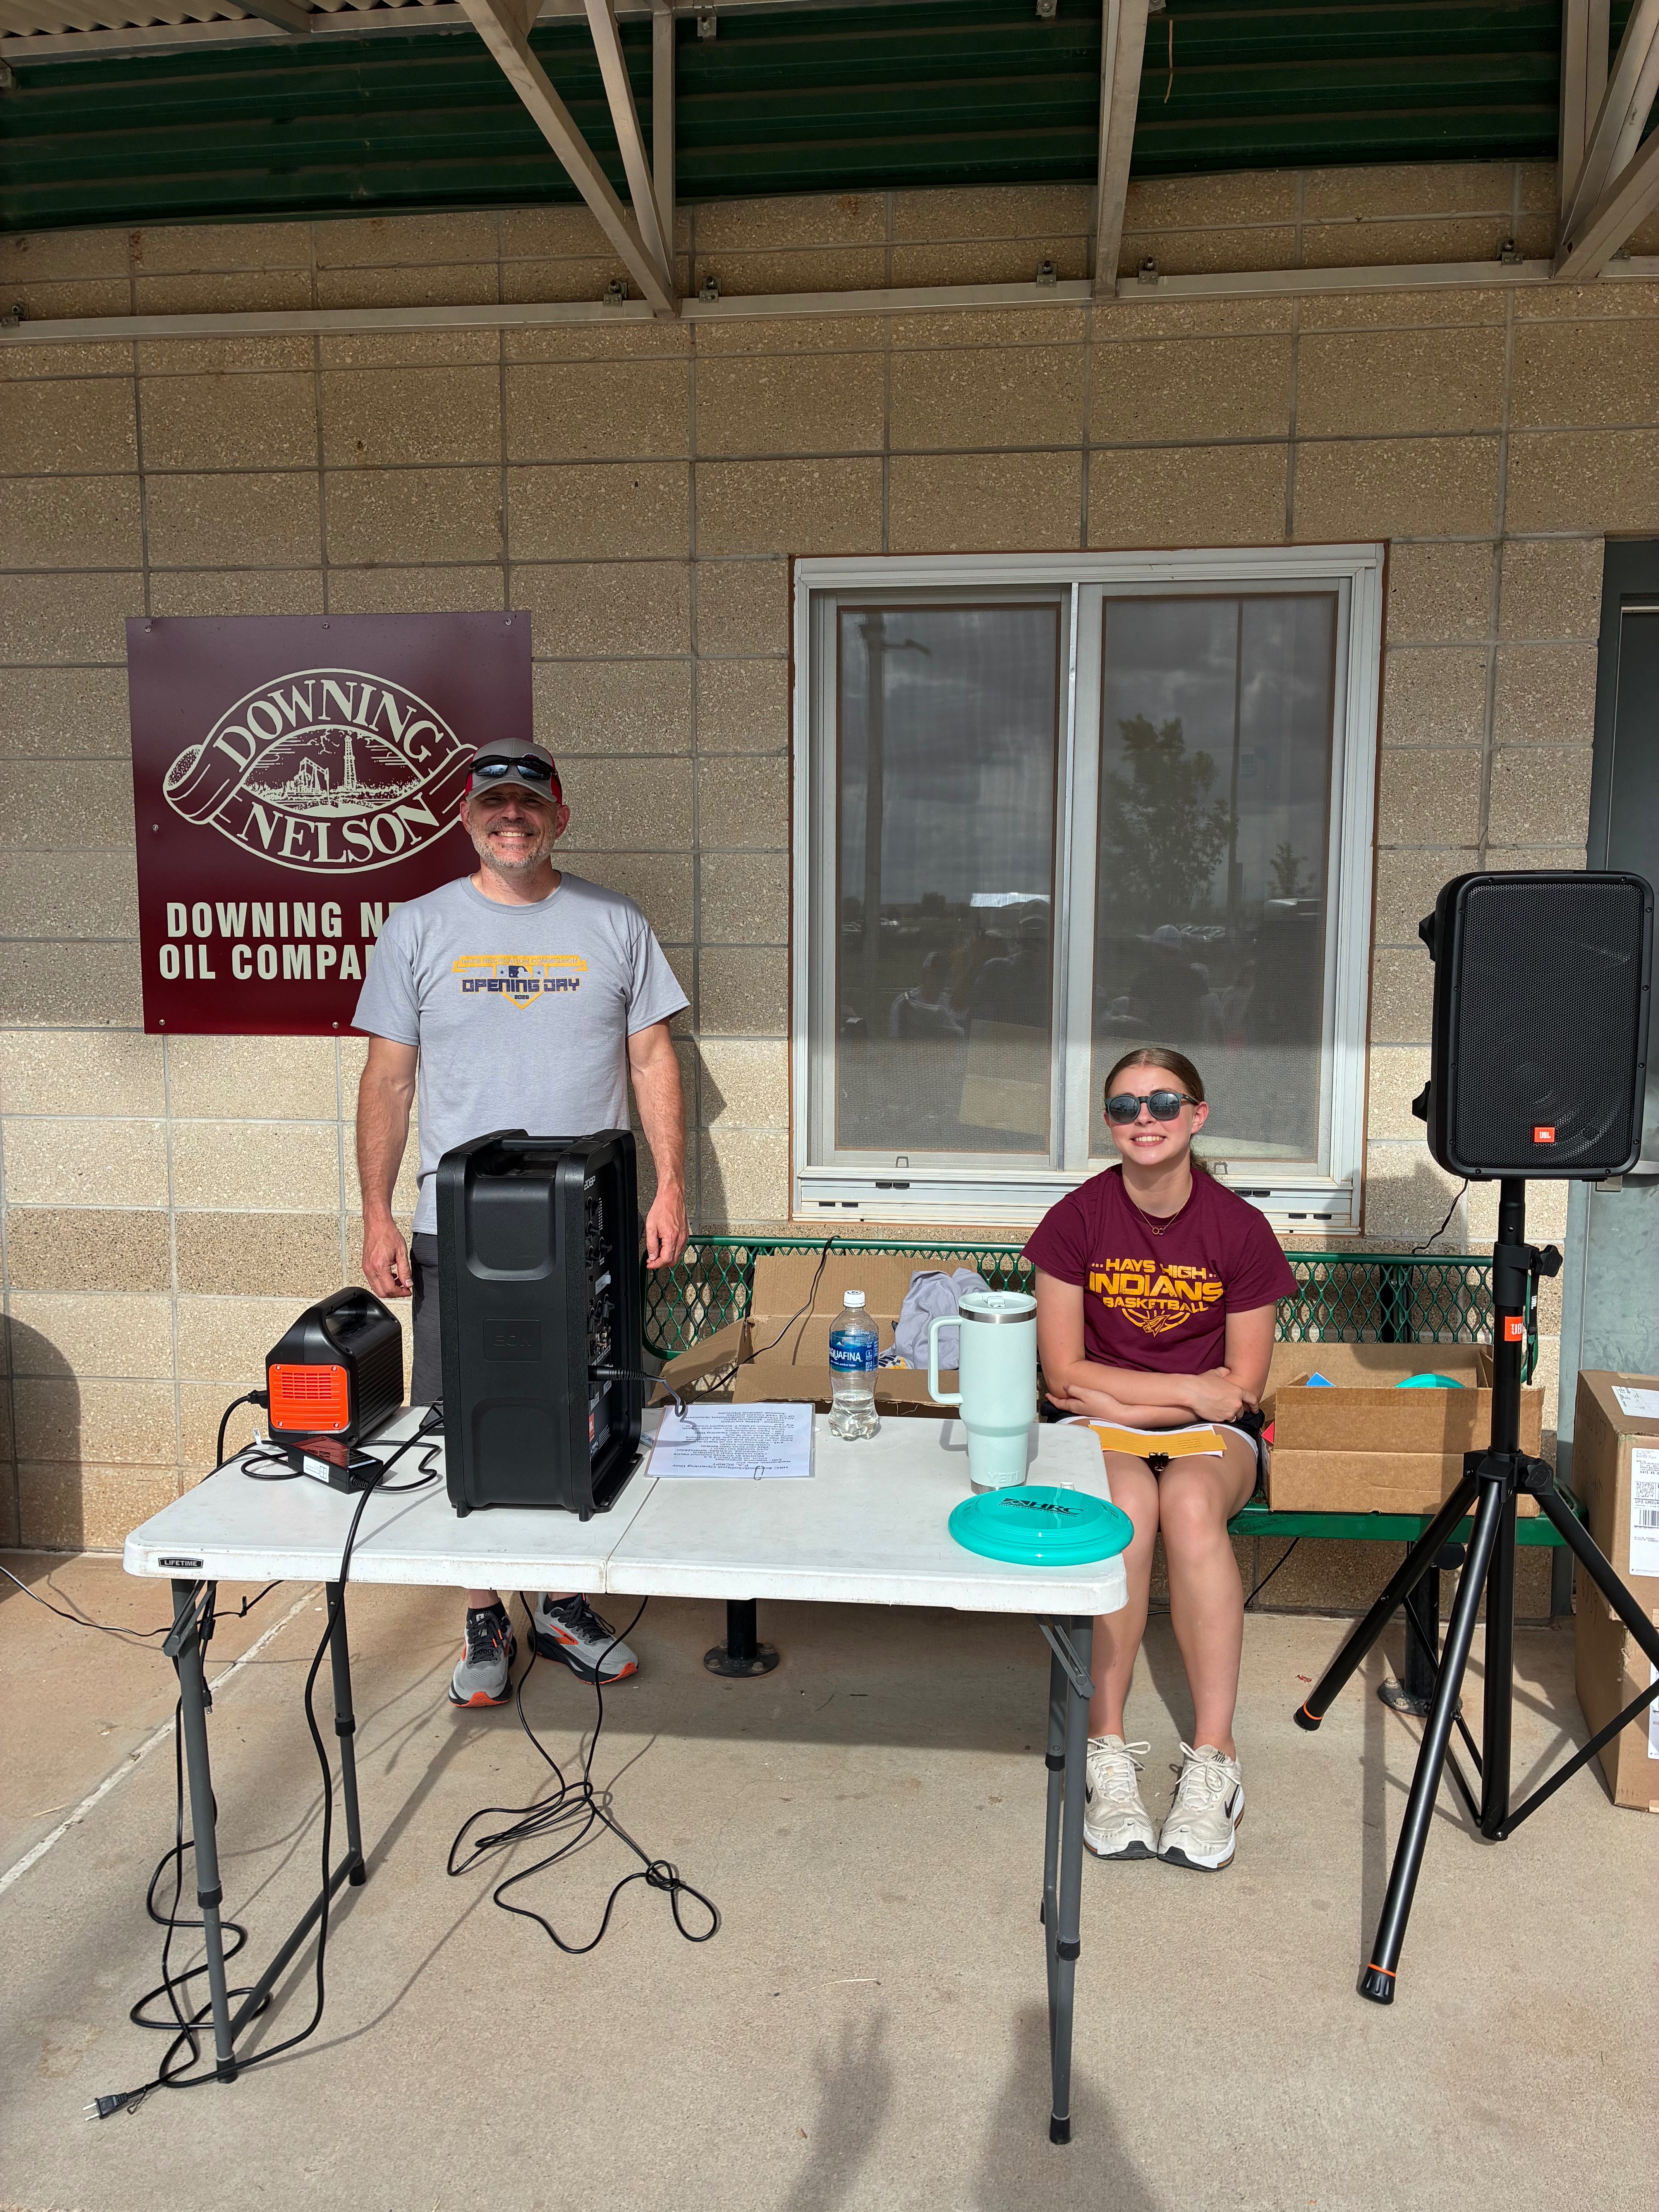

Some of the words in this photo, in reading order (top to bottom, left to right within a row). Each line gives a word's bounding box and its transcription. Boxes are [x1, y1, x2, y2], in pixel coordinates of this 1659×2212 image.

[215, 679, 443, 772] DOWNING
[236, 793, 440, 863] NELSON
[167, 902, 342, 938] DOWNING
[159, 944, 216, 979] OIL
[462, 978, 540, 993] OPENING
[543, 978, 580, 992] DAY
[1106, 1258, 1156, 1273] HAYS
[1159, 1263, 1207, 1280] HIGH
[1089, 1271, 1224, 1302] INDIANS
[1103, 1297, 1209, 1313] BASKETBALL
[987, 1470, 1020, 1484] YETI
[1029, 1501, 1084, 1515] HRC
